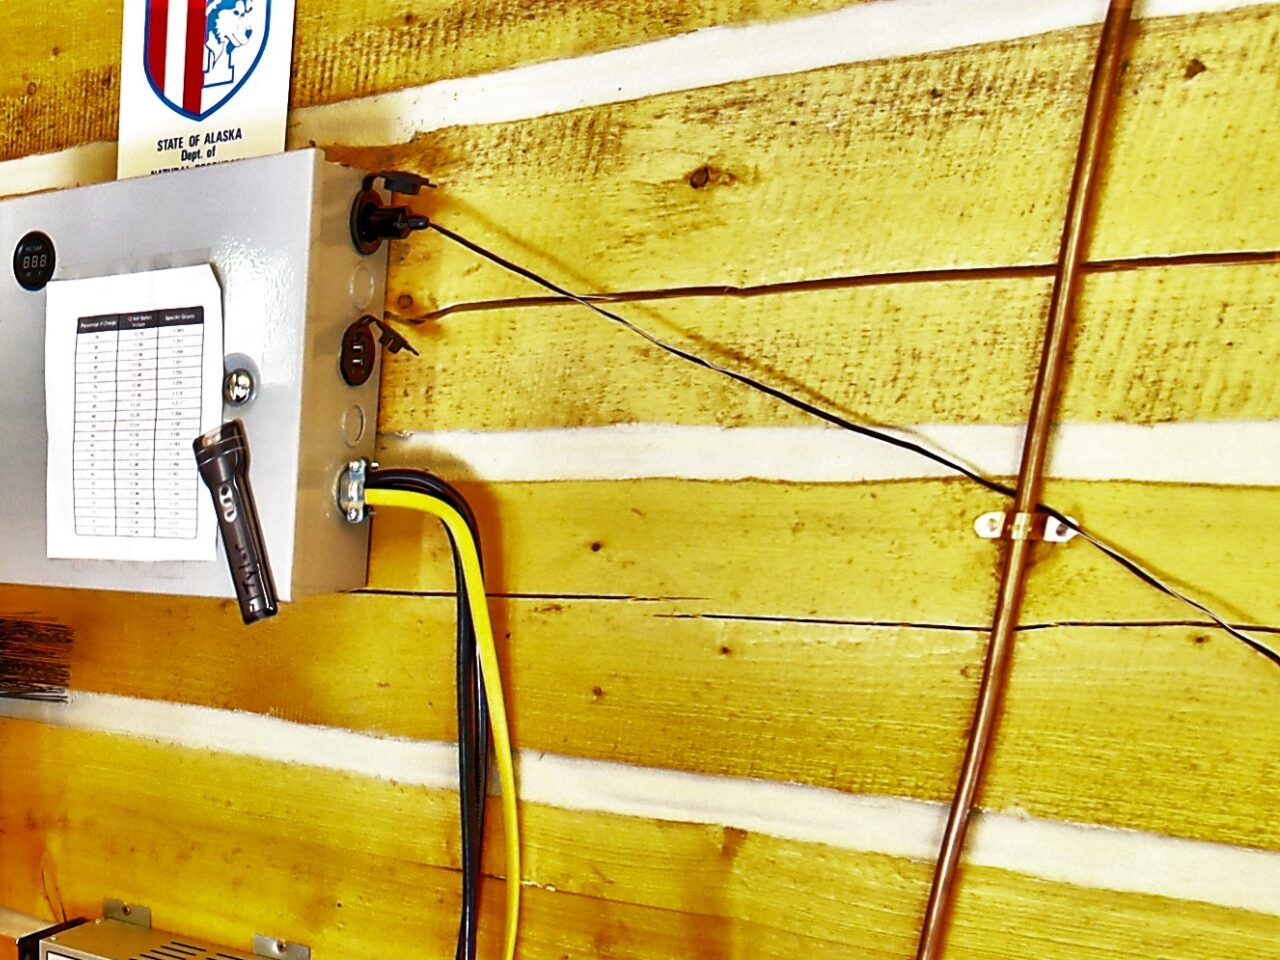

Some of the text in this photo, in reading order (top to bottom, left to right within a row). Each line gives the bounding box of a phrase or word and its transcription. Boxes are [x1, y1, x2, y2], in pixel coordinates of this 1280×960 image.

[157, 128, 242, 152] STATE OF ALASKA
[181, 145, 216, 162] Dept. of
